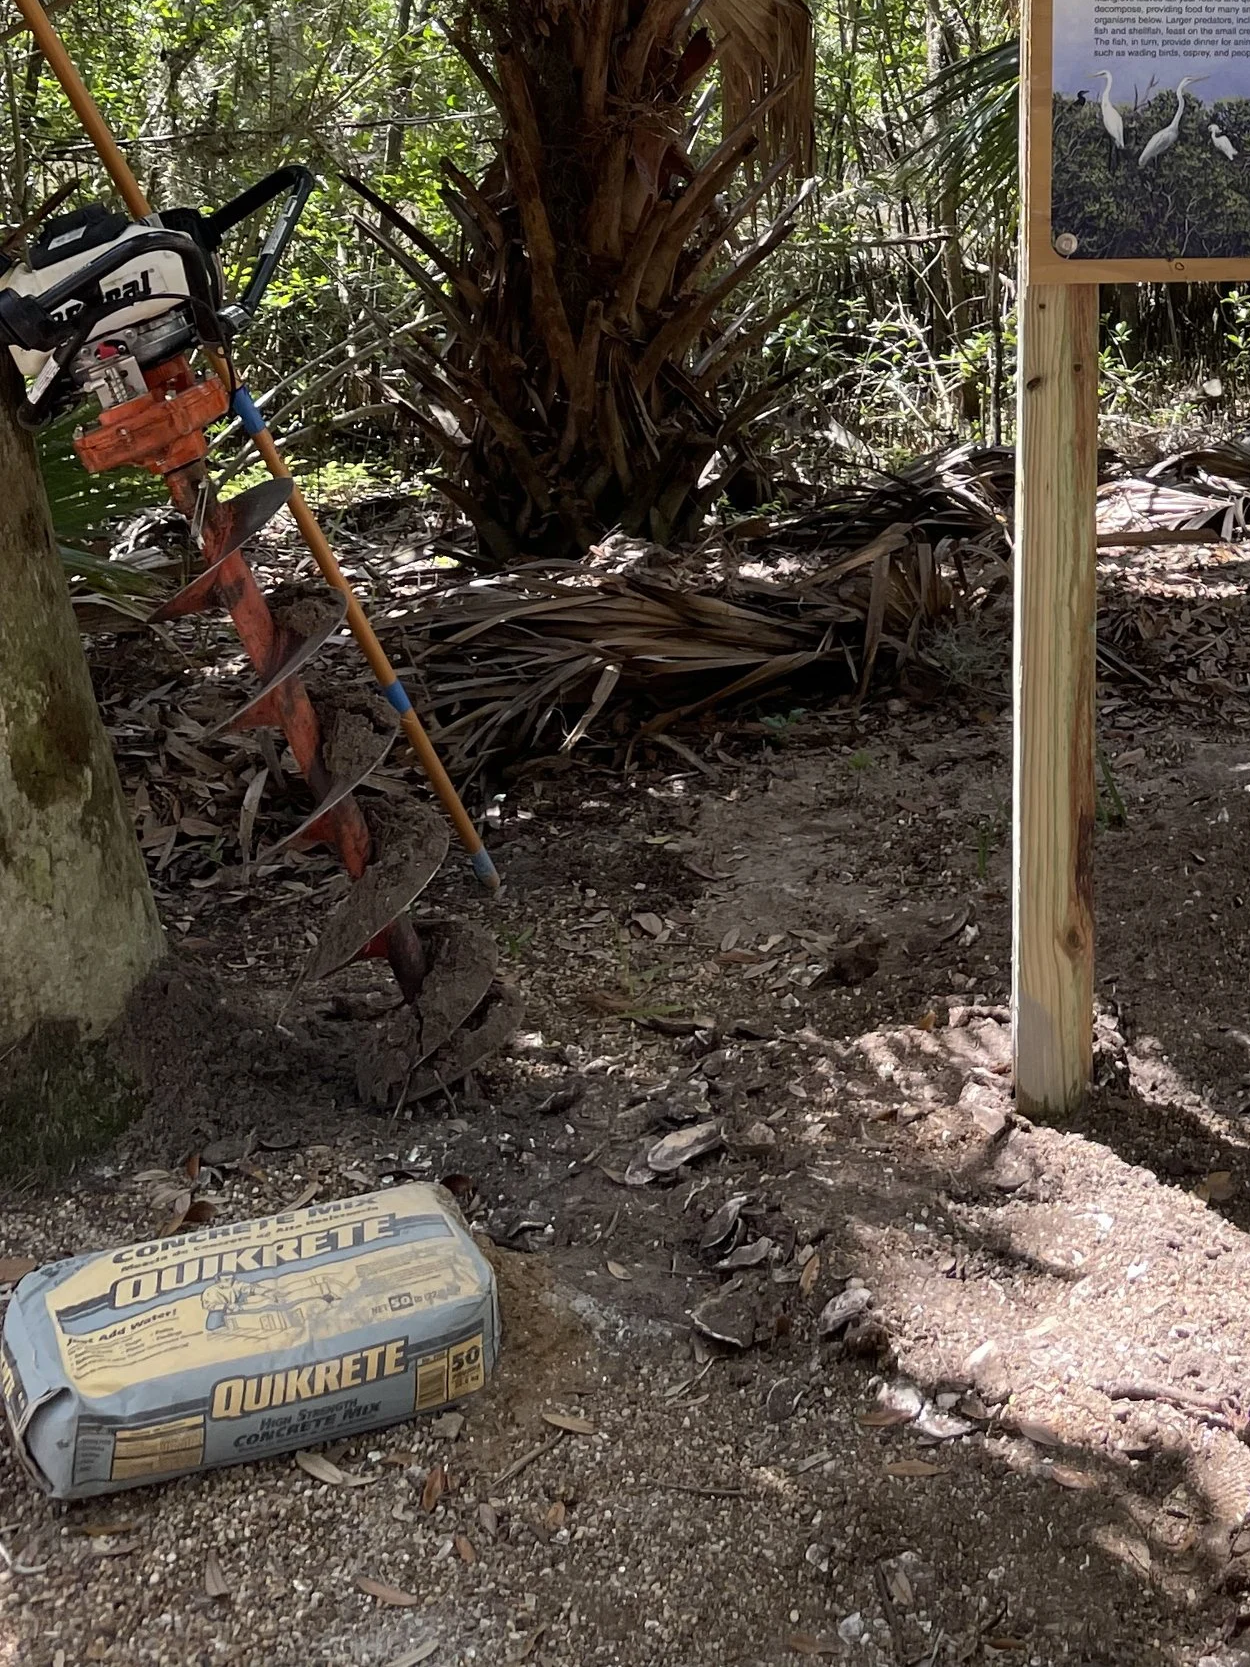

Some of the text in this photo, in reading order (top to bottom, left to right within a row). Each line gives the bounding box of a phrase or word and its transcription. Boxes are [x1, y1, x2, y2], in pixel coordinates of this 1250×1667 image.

[1166, 17, 1192, 25] Larger
[1128, 27, 1163, 36] shellfish,
[1162, 38, 1191, 46] provide
[1128, 50, 1156, 58] wading
[112, 1214, 295, 1264] CONCRETE
[308, 1197, 377, 1218] MIX
[114, 1214, 395, 1308] QUIKRETE
[390, 1294, 412, 1310] 50
[99, 1327, 126, 1341] Add
[452, 1345, 480, 1372] 50
[211, 1339, 405, 1419] QUIKRETE
[233, 1415, 336, 1447] CONCRETE
[342, 1401, 382, 1425] MIX
